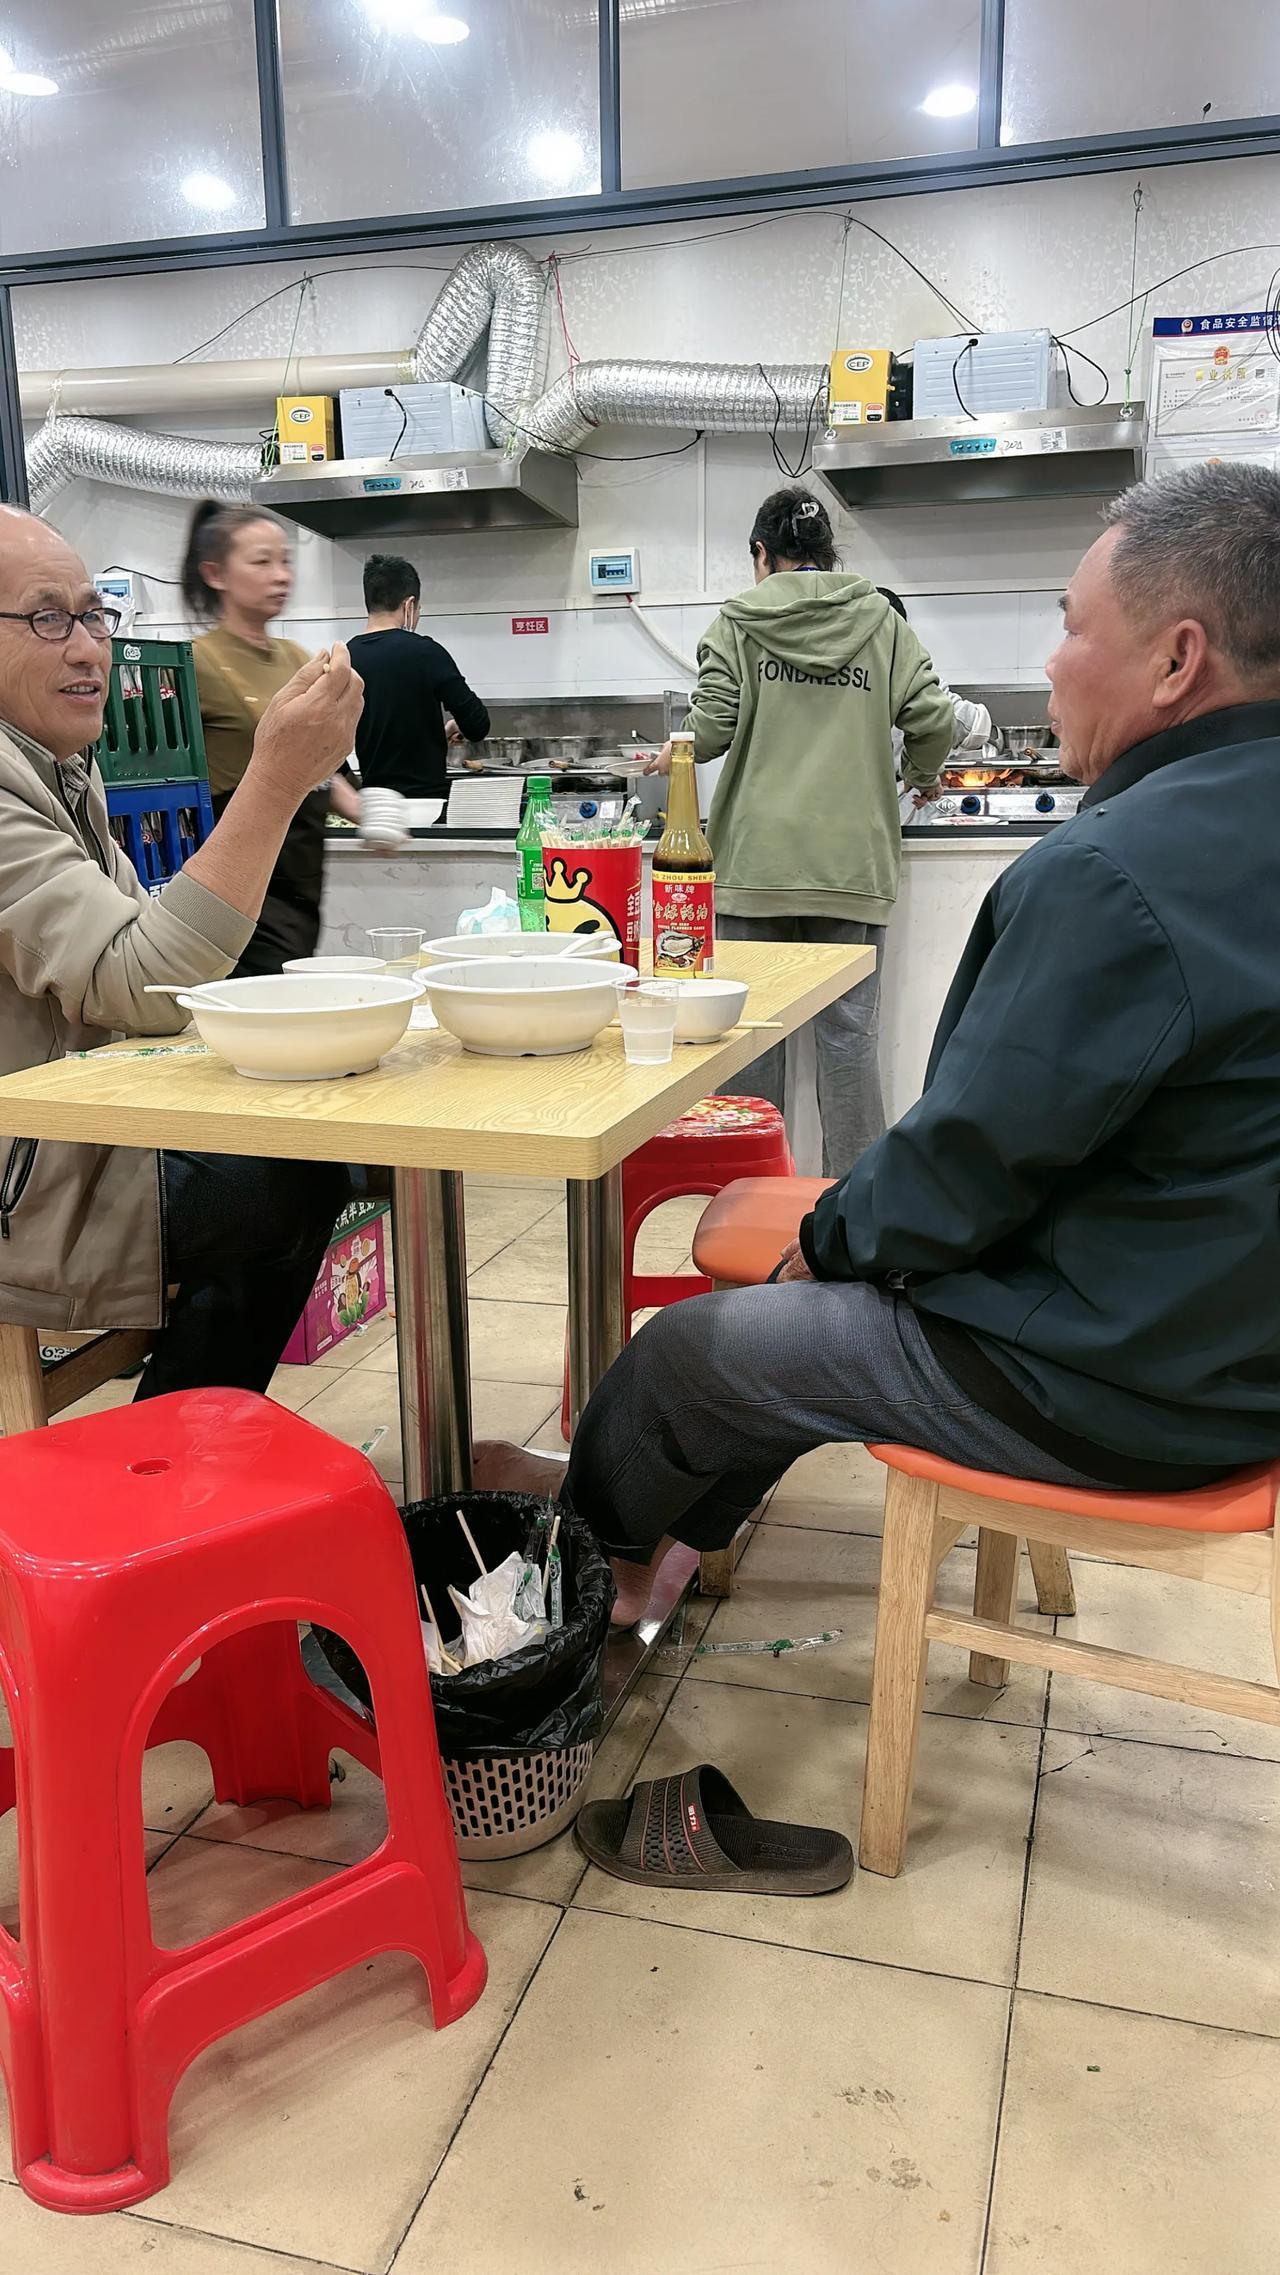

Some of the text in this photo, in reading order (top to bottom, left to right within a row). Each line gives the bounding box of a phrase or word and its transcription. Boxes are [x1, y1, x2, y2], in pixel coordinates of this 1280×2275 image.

[1200, 314, 1280, 331] 食品安全监督
